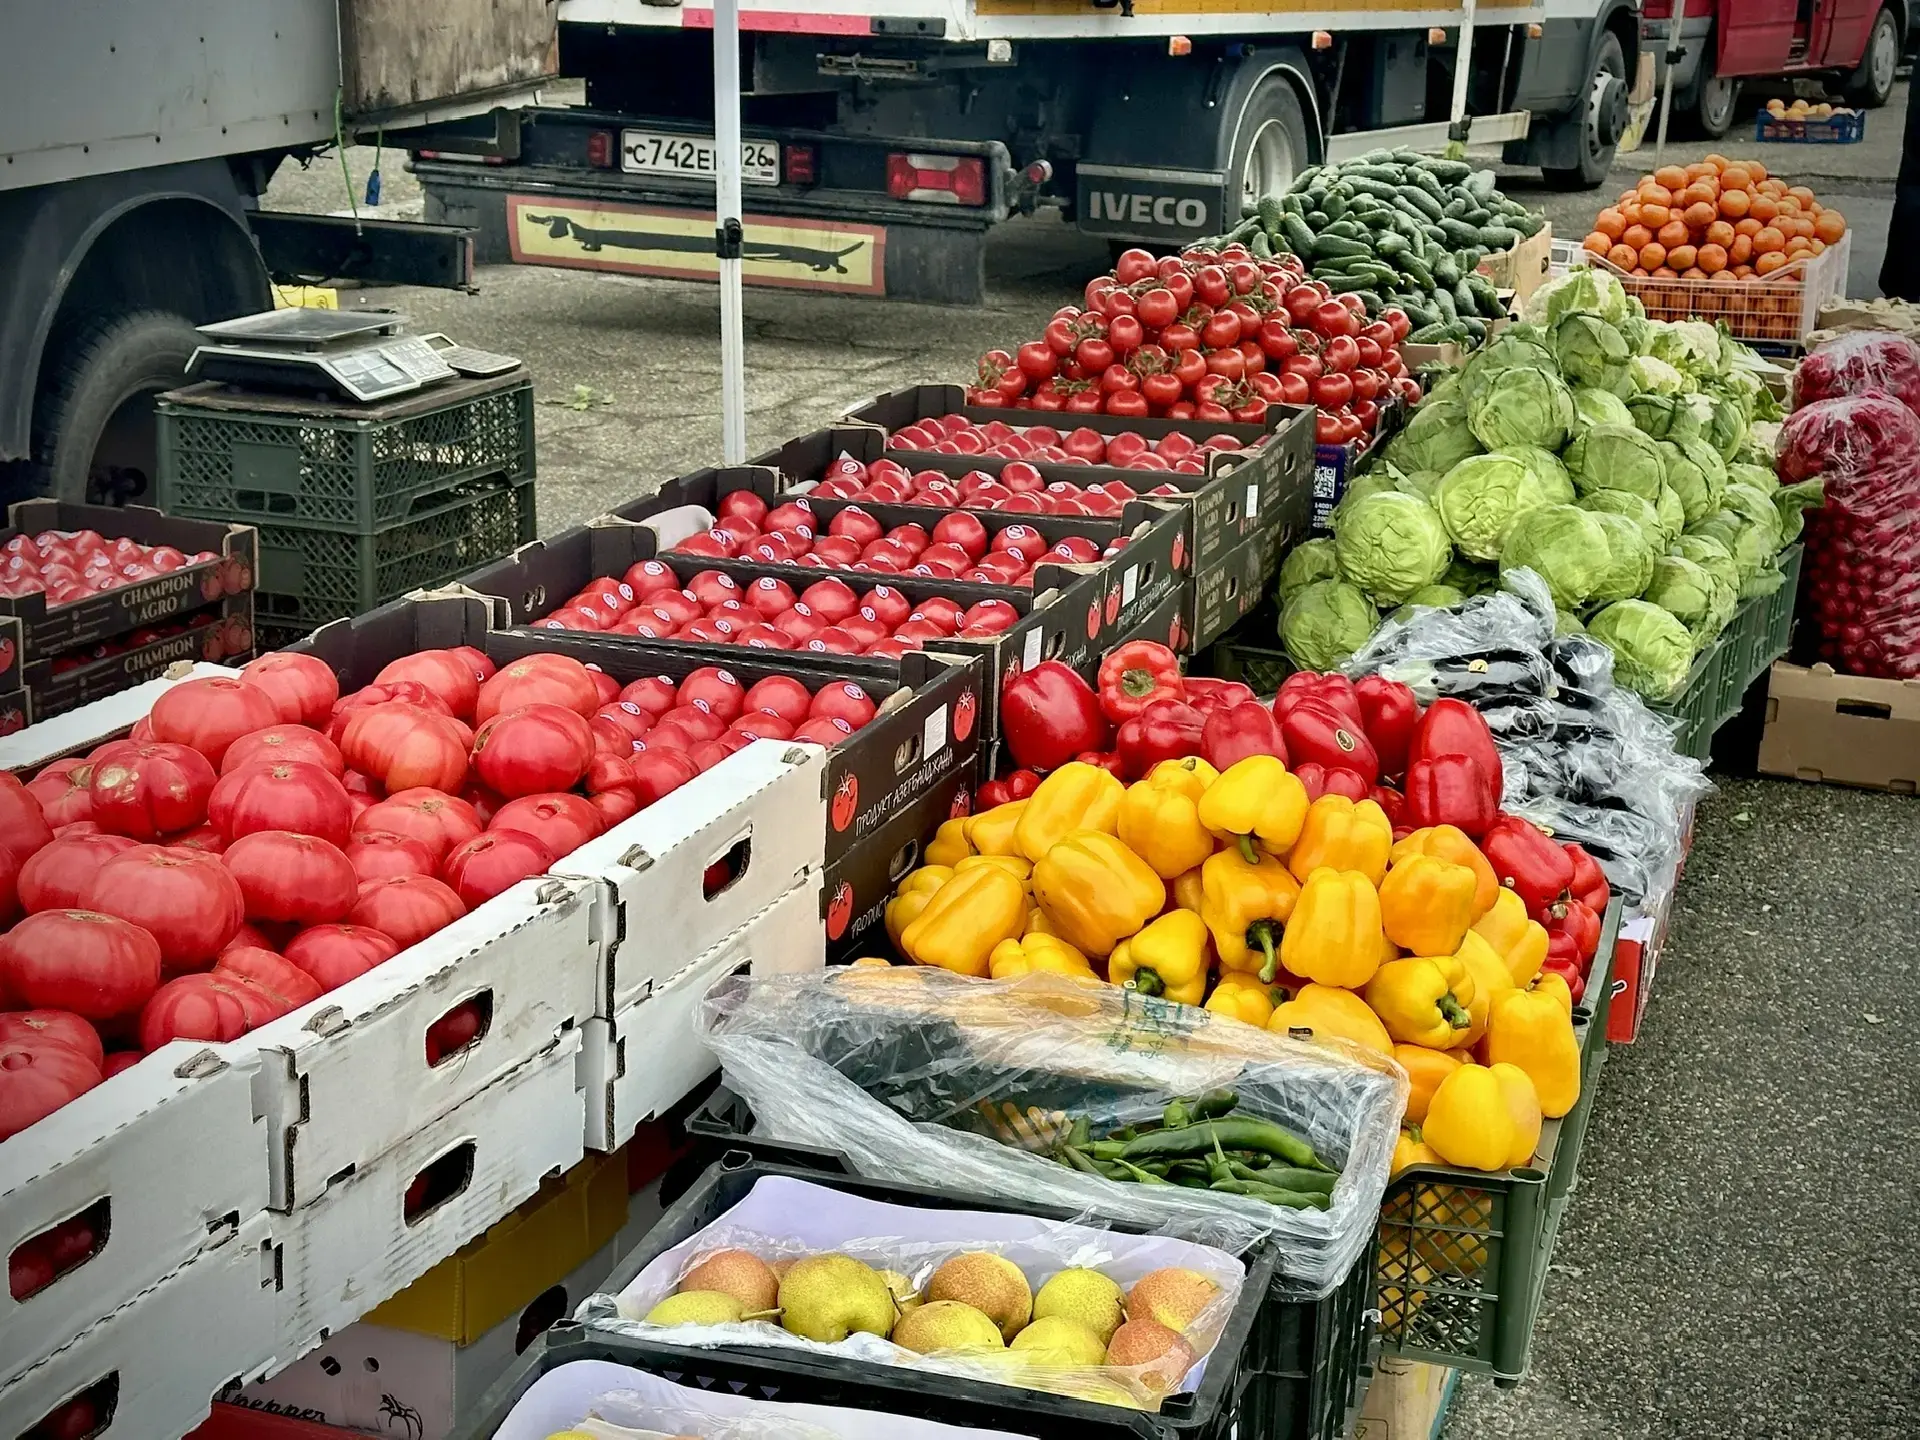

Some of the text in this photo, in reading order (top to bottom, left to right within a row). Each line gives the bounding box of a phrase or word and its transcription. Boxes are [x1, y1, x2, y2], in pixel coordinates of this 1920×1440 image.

[632, 138, 769, 171] С742Е 26
[1090, 191, 1207, 227] IVECO
[1198, 487, 1225, 517] CHAMPION
[1204, 509, 1219, 529] AGRO
[121, 573, 195, 608] CHAMPION
[139, 596, 178, 621] AGRO
[124, 636, 195, 674] CHAMPION
[856, 746, 954, 836] ПРОДУКТ АЗЕРБАЙДЖАНА
